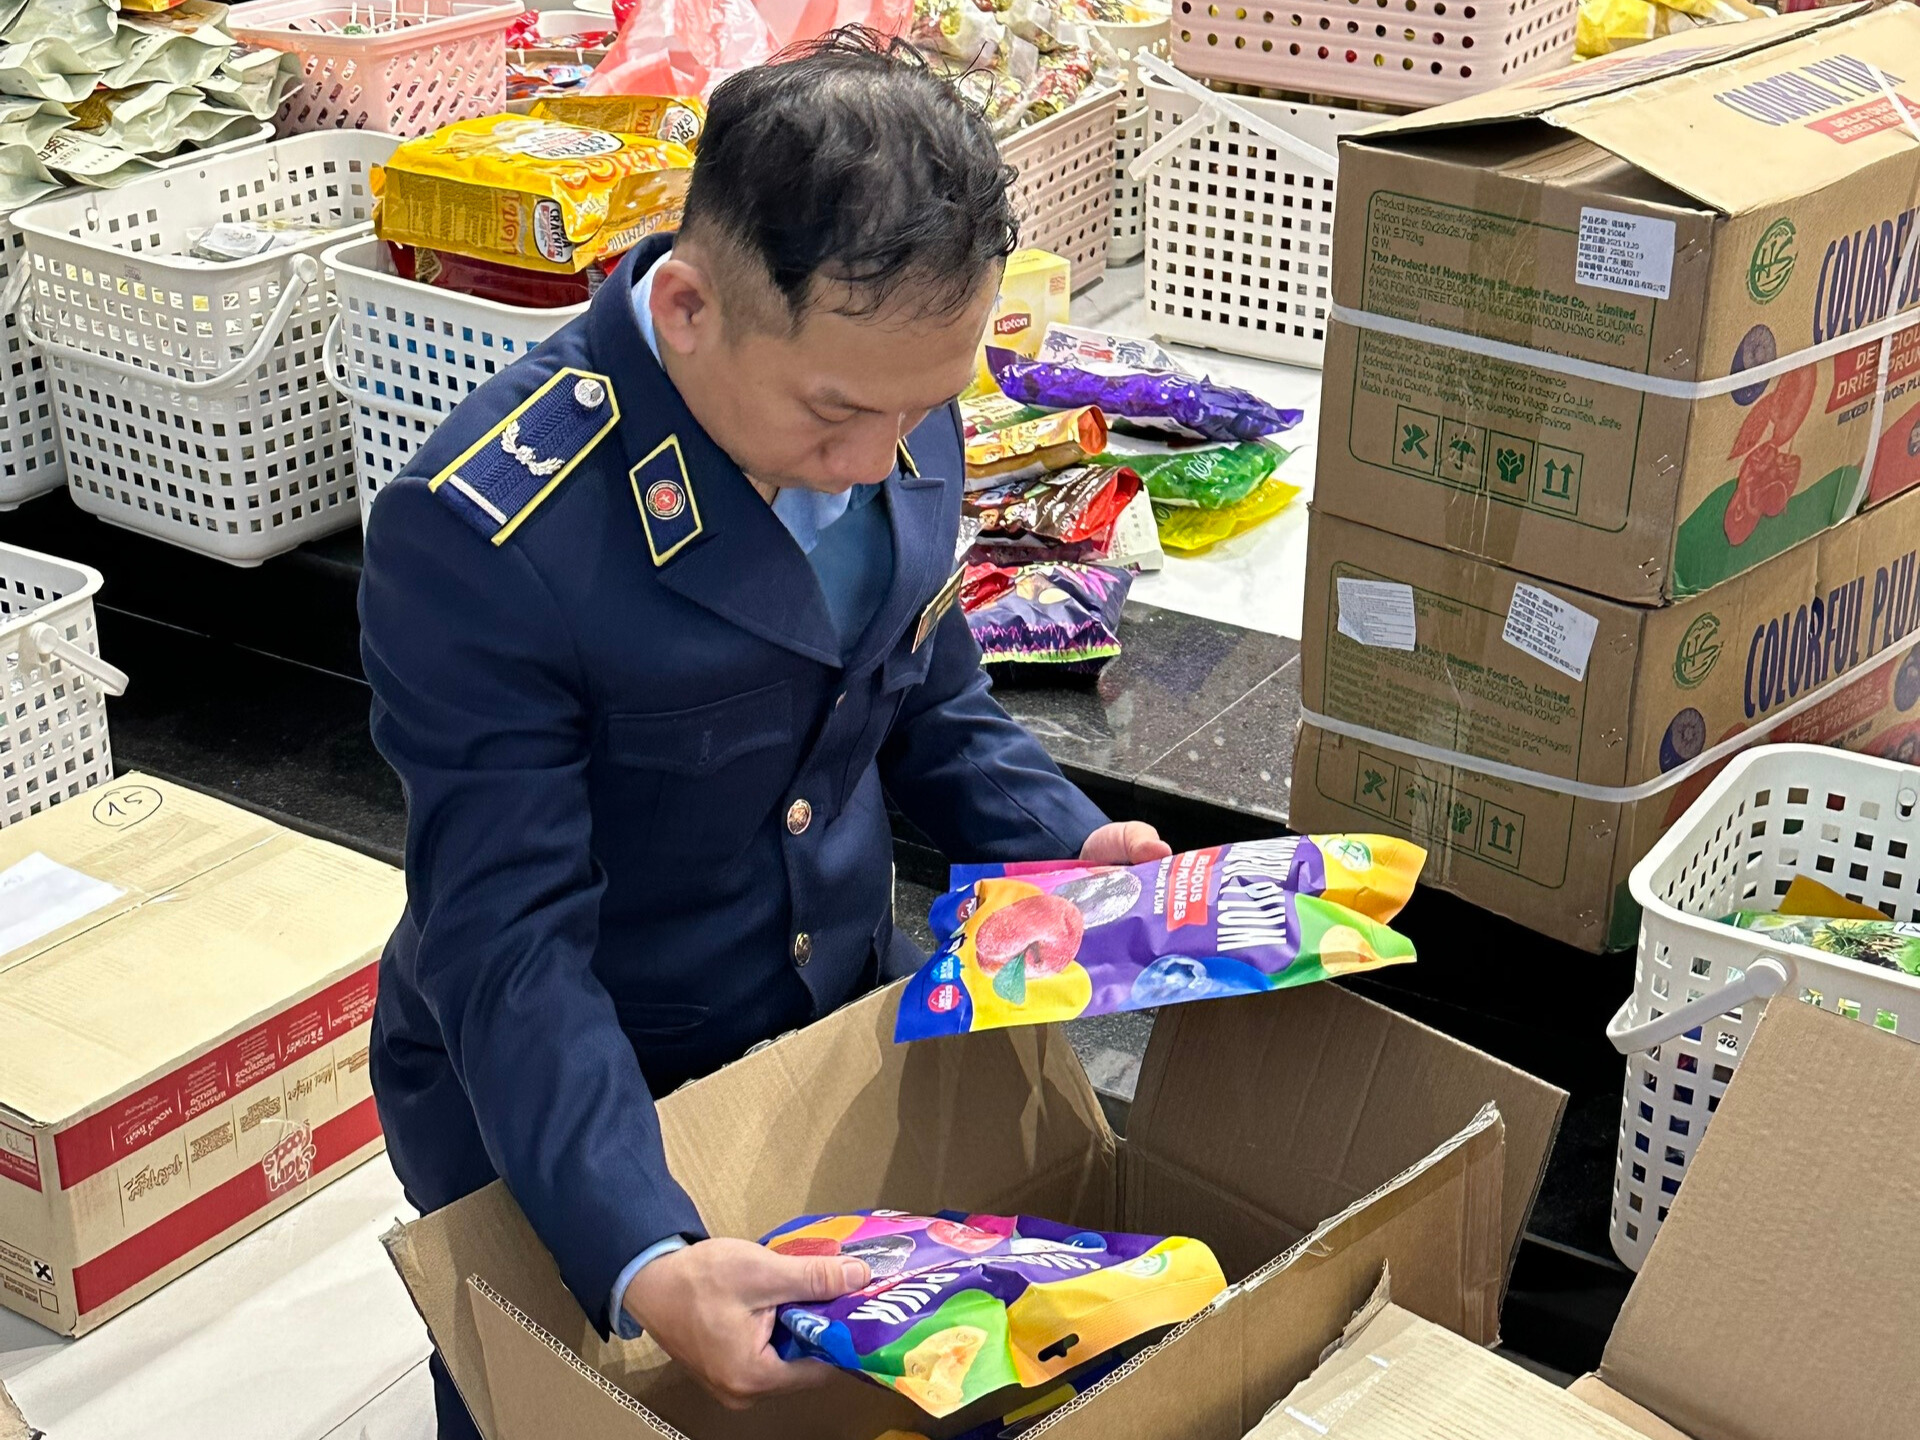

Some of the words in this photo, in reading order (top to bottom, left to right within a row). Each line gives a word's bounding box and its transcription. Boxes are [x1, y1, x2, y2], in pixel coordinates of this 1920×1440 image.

[1713, 71, 1855, 127] COLORFUL
[549, 208, 565, 260] CRACKER
[1370, 249, 1389, 263] The
[1389, 254, 1428, 272] Product
[1428, 262, 1441, 275] of
[1441, 266, 1468, 284] Hong
[1469, 272, 1497, 290] Kong
[1542, 289, 1569, 305] Food
[1595, 301, 1637, 321] Limited
[996, 315, 1028, 333] Lipton
[1538, 301, 1595, 325] INDUSTRIAL
[1504, 376, 1528, 392] Food
[1744, 576, 1866, 719] COLORFUL
[1486, 665, 1510, 684] Food
[1532, 682, 1570, 705] Limited
[1216, 881, 1288, 952] PLUM
[847, 1272, 960, 1325] PLUM
